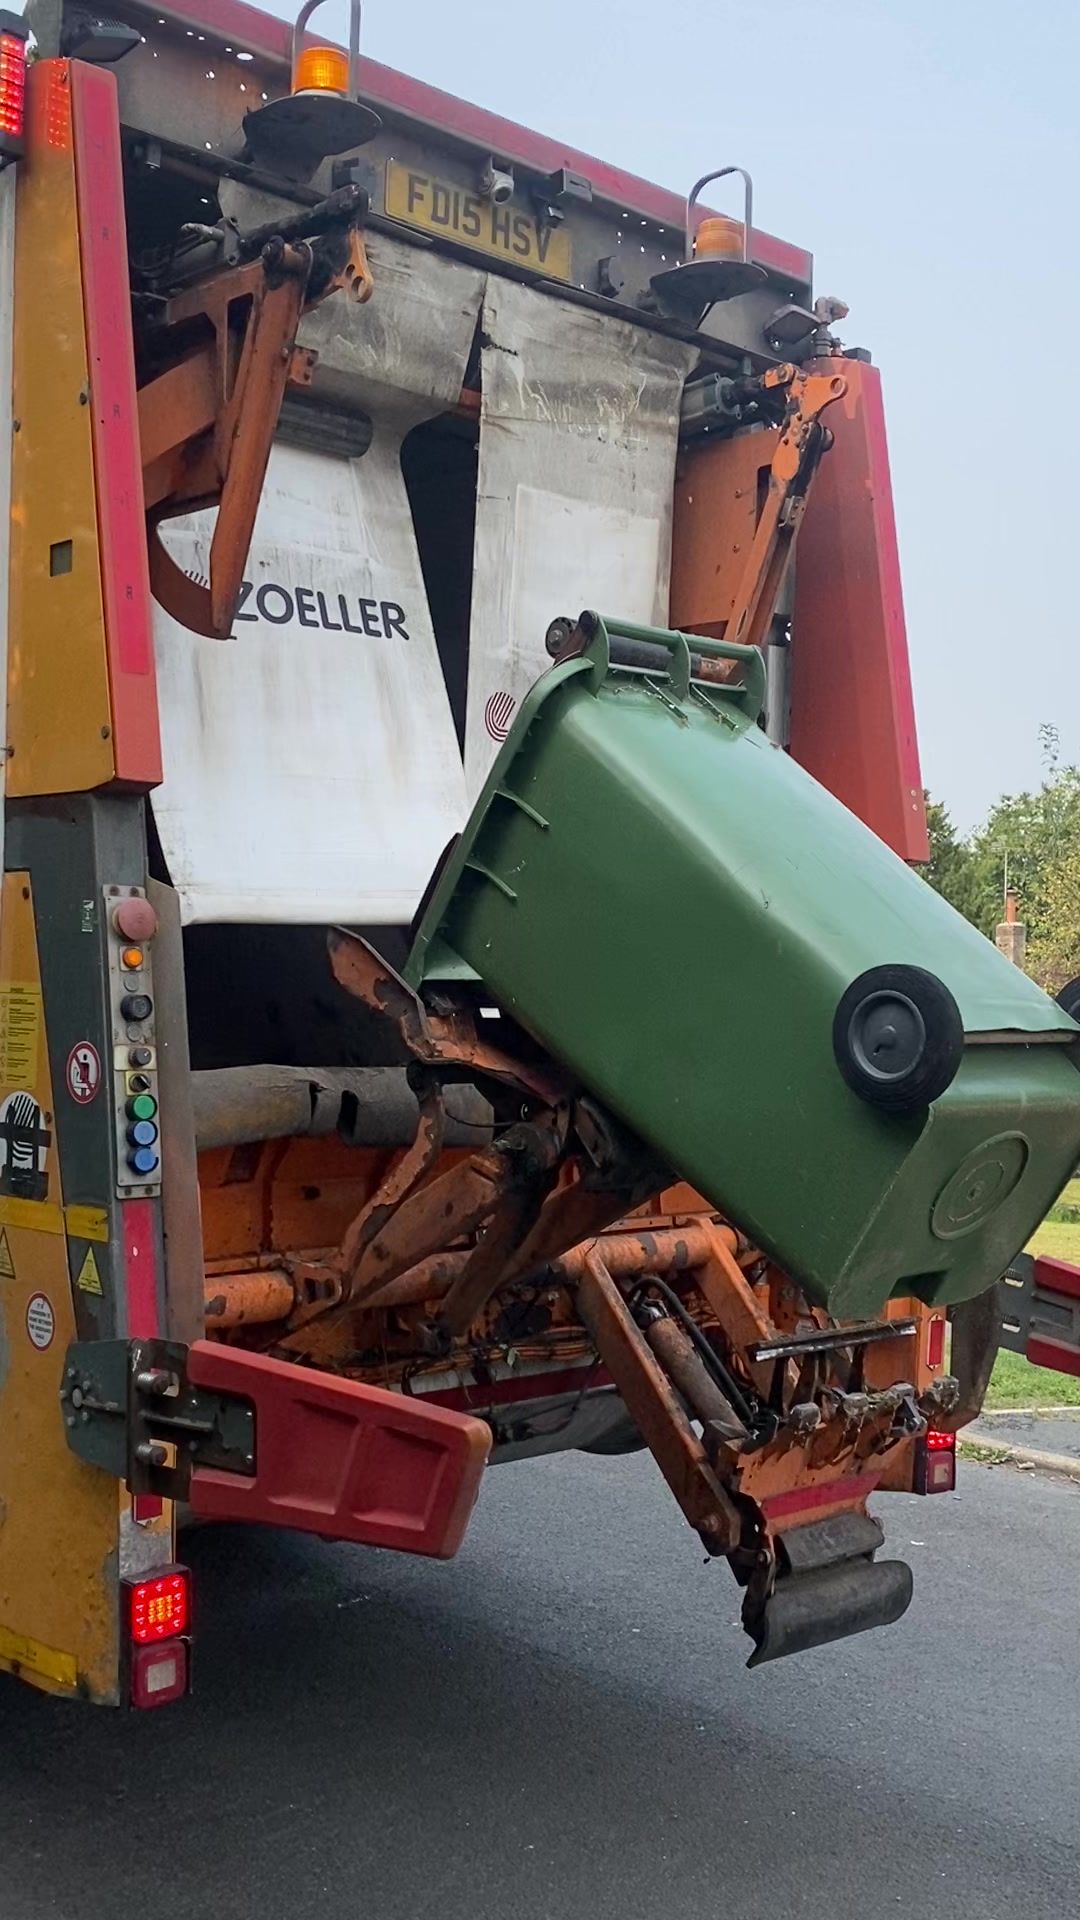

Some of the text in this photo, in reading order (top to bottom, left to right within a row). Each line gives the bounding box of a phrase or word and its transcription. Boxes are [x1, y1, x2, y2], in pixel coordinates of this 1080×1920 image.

[408, 173, 552, 263] FD15 HSV
[234, 581, 410, 641] ZOELLER
